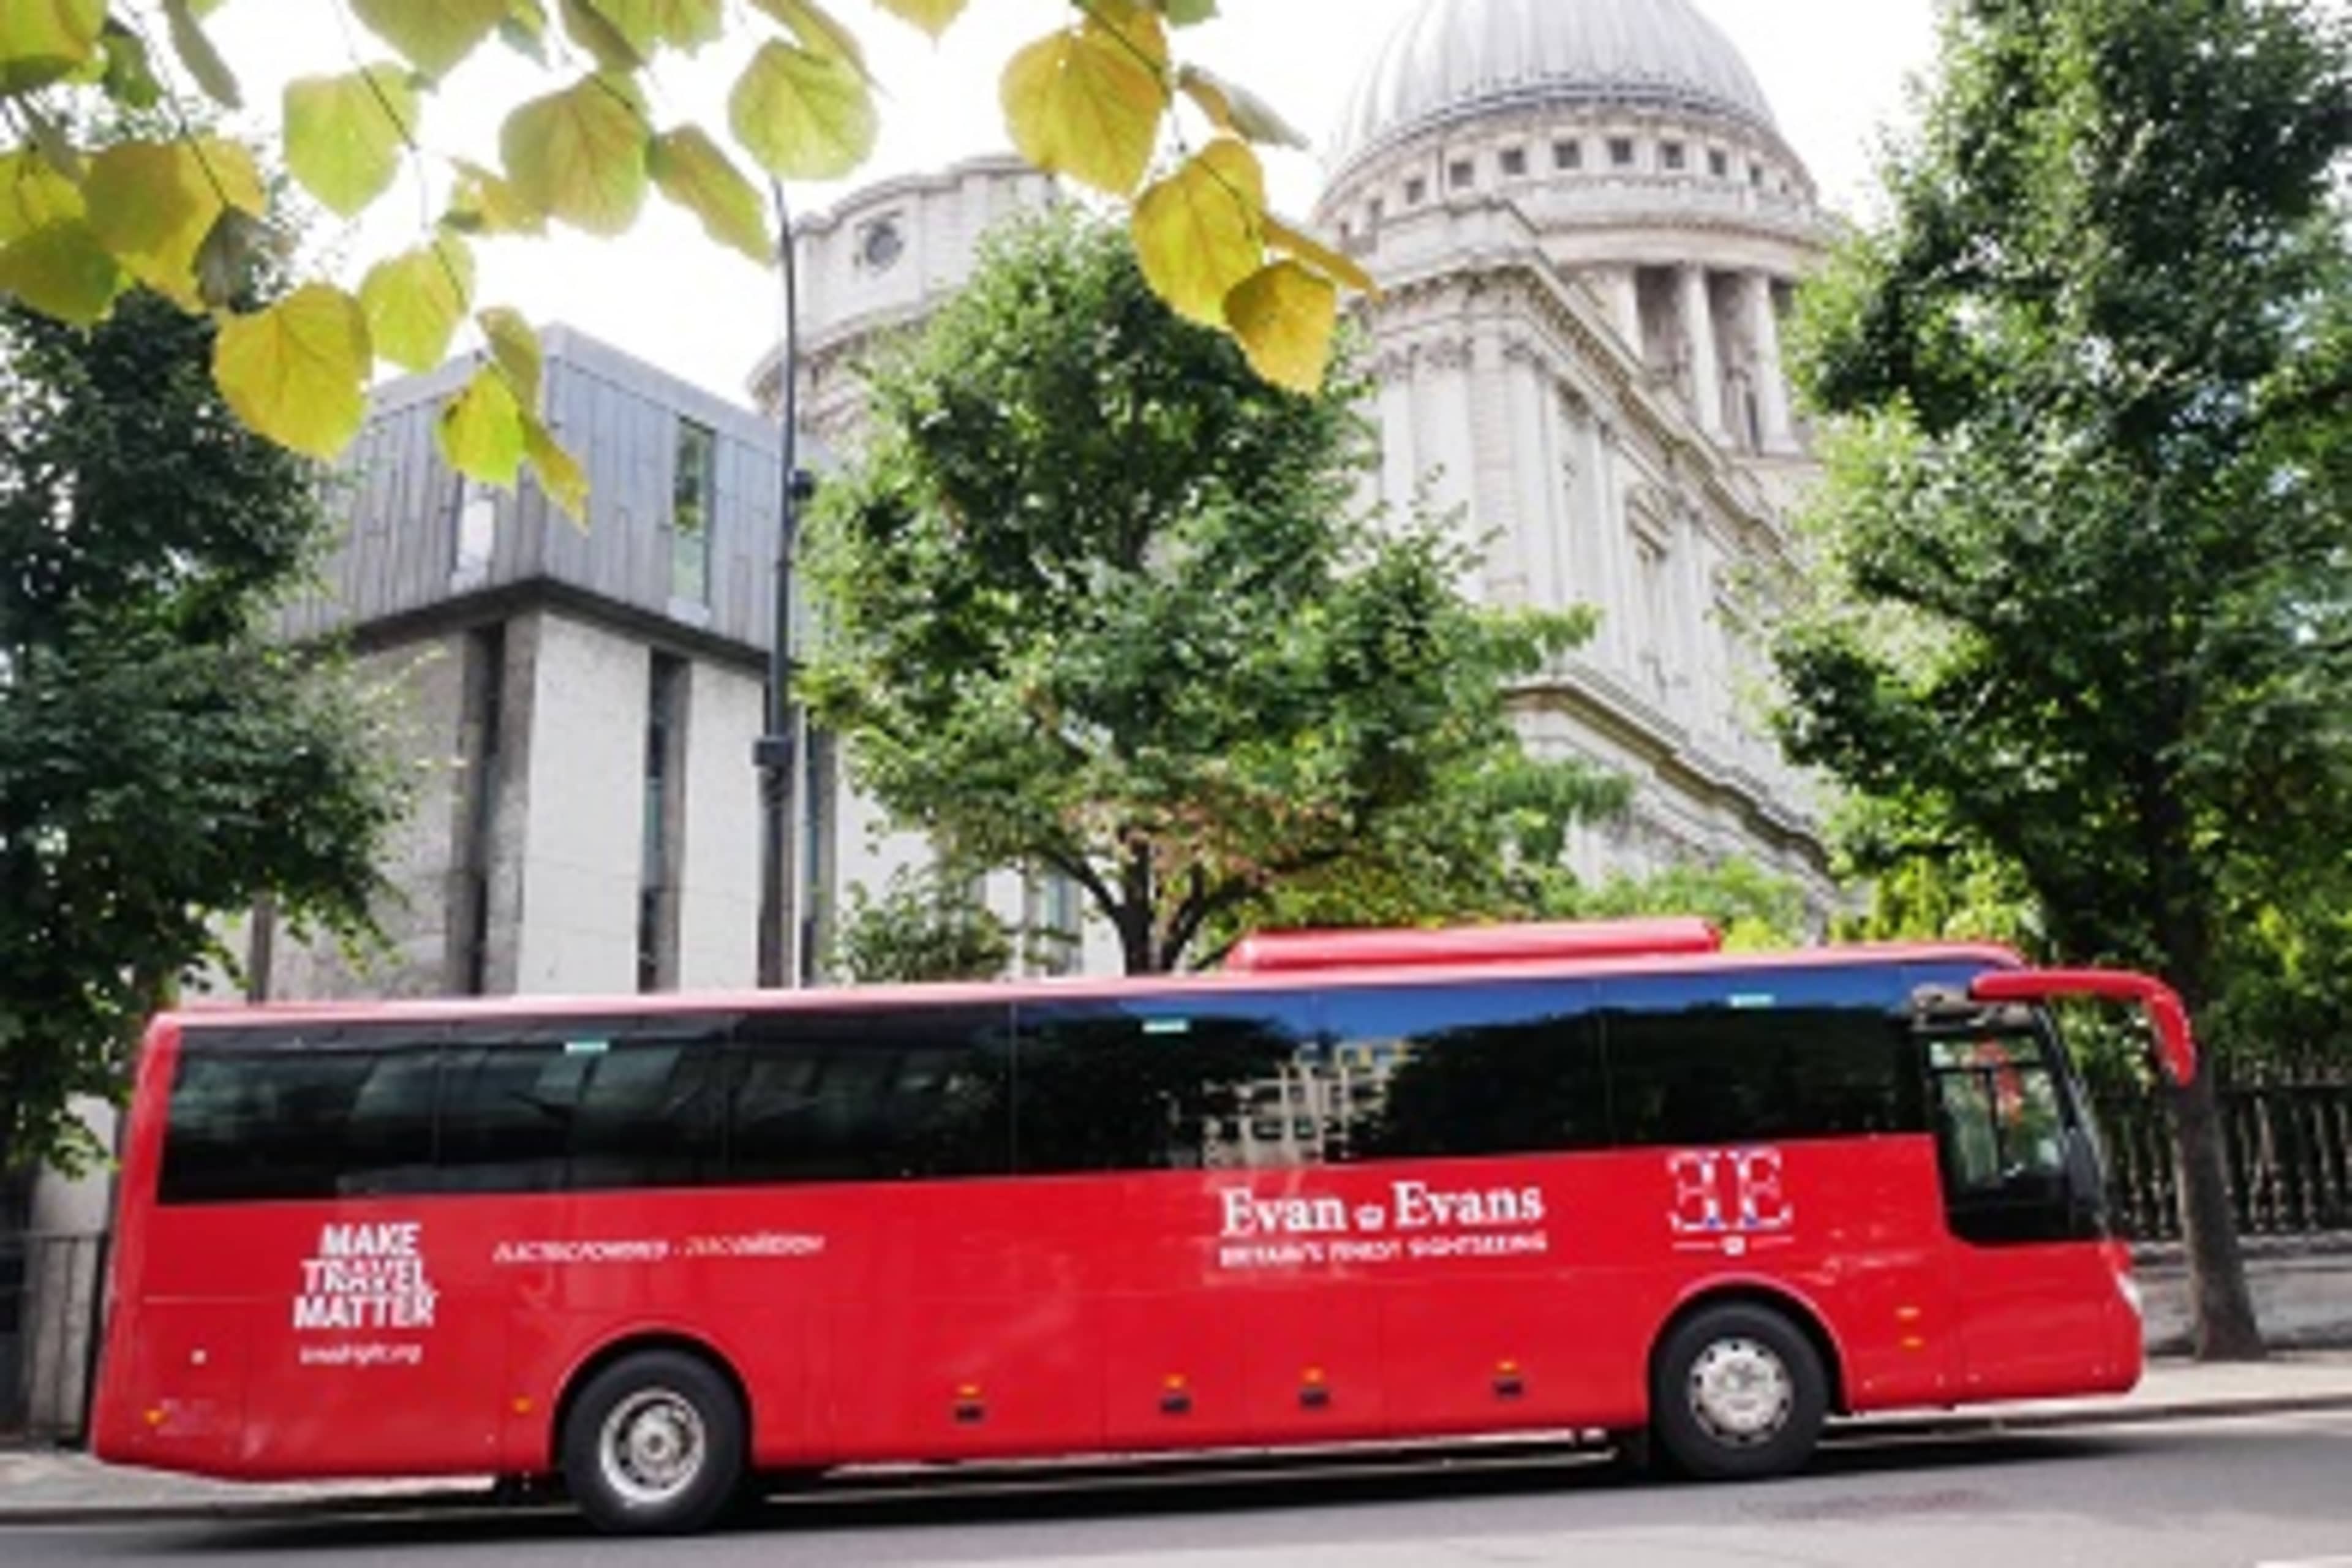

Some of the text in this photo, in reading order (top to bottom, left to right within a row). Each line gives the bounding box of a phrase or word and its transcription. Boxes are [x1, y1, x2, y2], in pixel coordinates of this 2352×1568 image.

[1221, 1180, 1545, 1237] Evan Evans
[319, 1223, 421, 1256] MAKE
[301, 1257, 432, 1294] TRAVEL
[293, 1292, 435, 1329] MATTER
